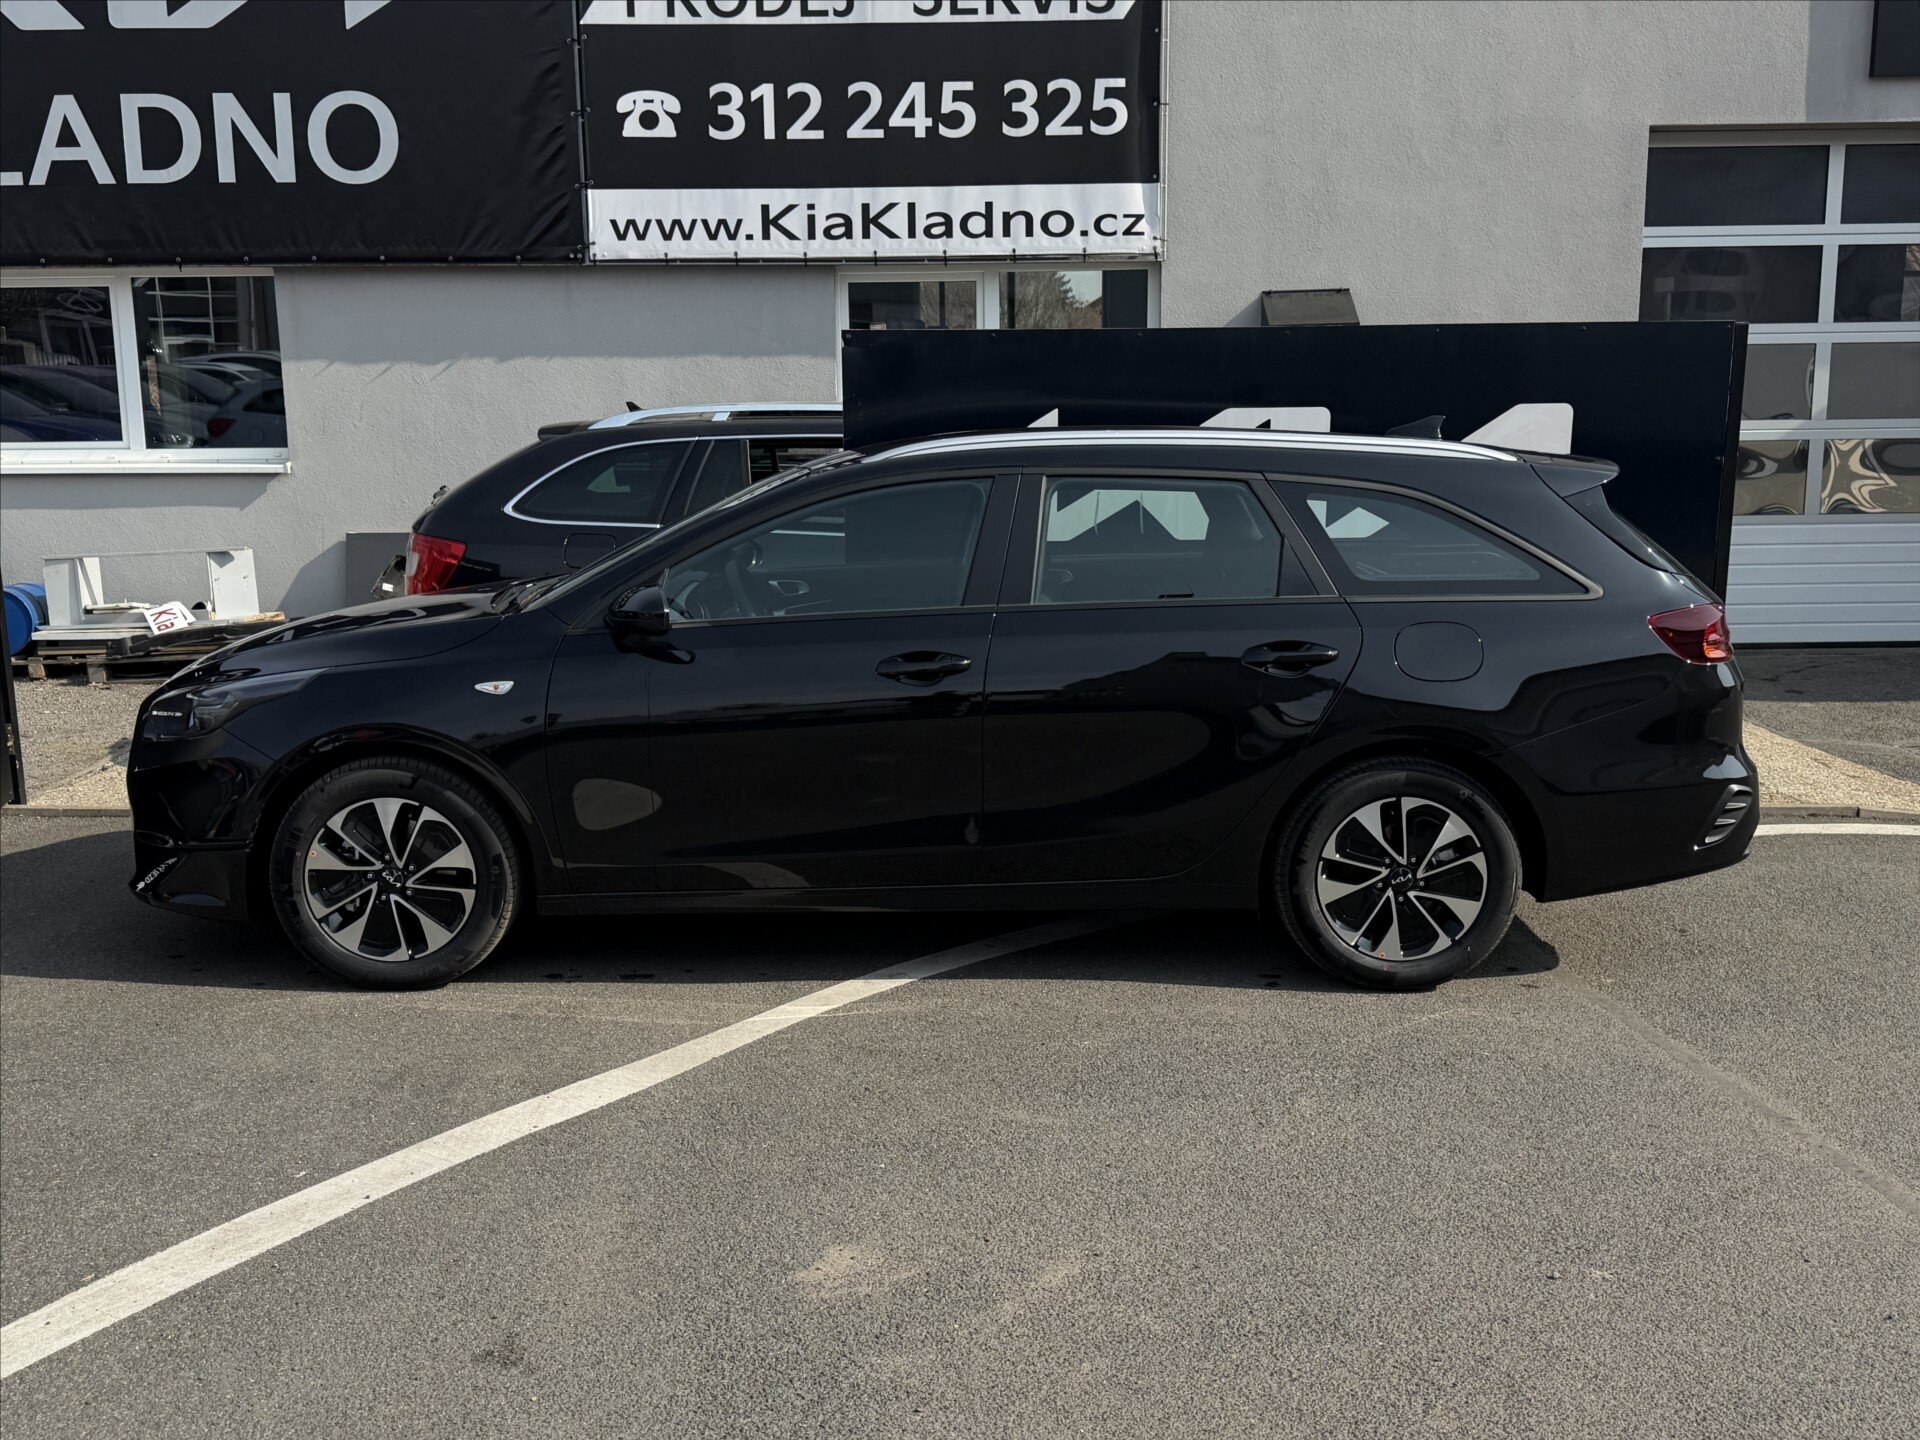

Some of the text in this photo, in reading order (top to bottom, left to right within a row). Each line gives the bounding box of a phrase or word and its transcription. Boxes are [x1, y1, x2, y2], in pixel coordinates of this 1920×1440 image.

[708, 77, 1129, 141] 312 245 325
[0, 93, 399, 186] ADNO
[609, 201, 1146, 242] www.KiaKladno.cz
[150, 608, 179, 632] Kia
